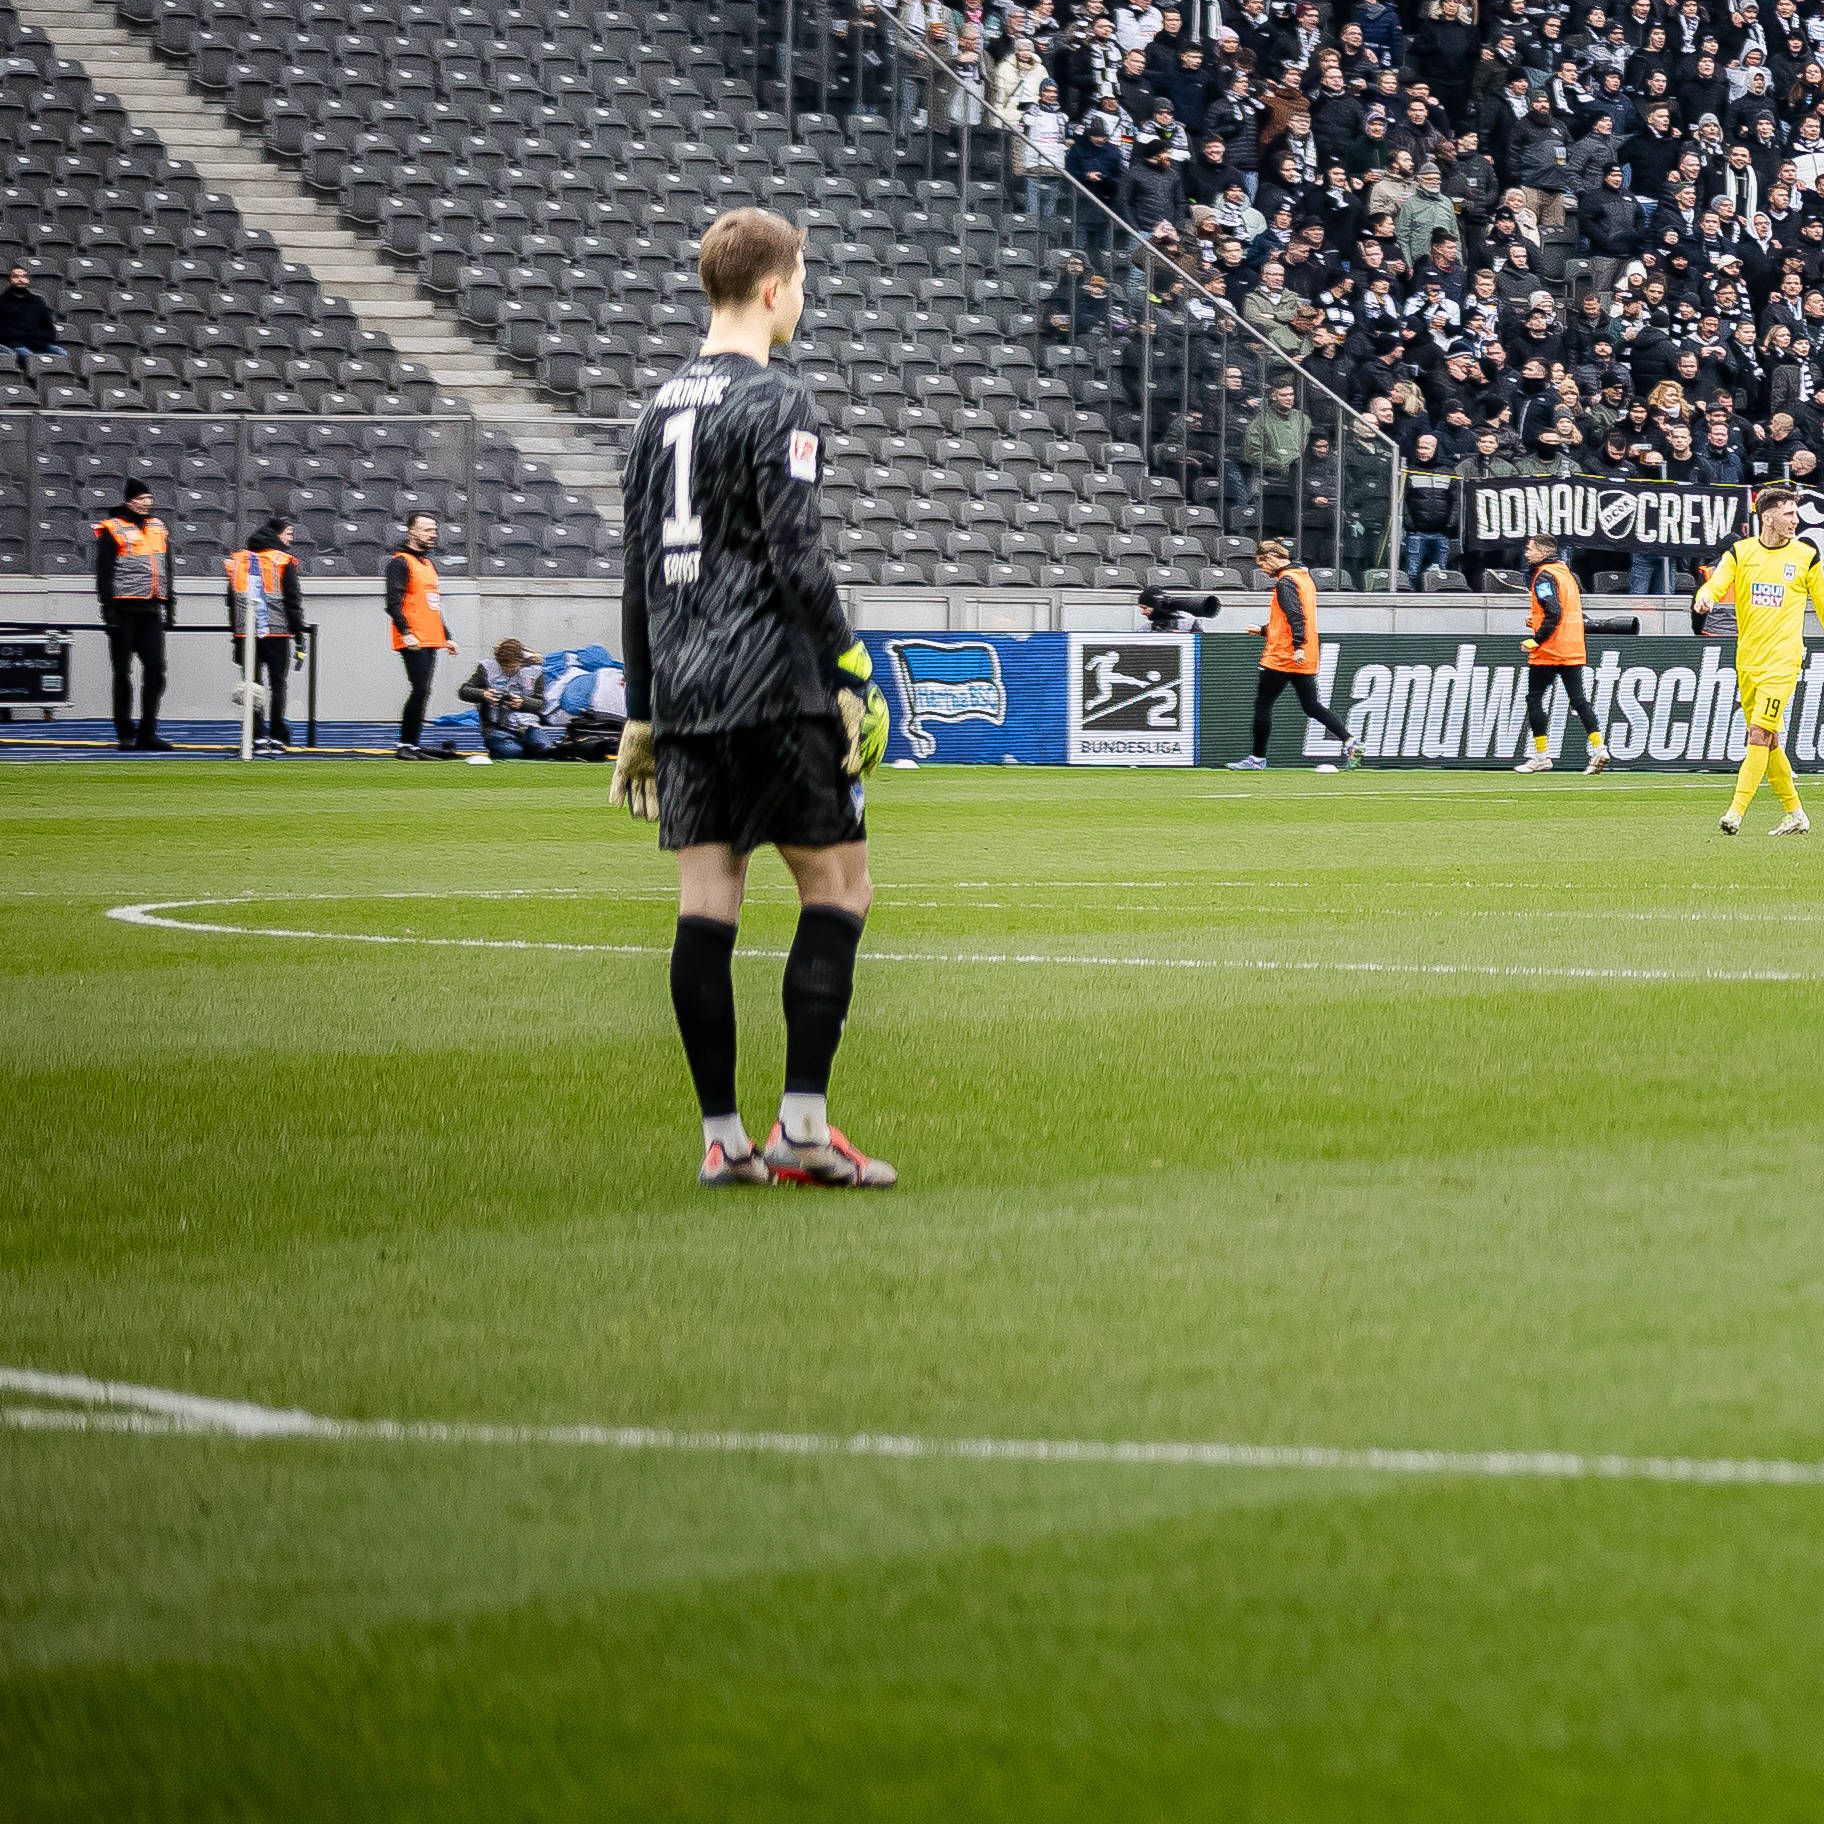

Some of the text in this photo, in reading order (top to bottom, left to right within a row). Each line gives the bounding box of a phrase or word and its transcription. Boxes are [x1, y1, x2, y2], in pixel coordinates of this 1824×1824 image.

[662, 407, 703, 548] 1
[1475, 482, 1599, 541] DONAU
[1635, 489, 1739, 547] CREW
[1753, 582, 1784, 597] LIQUI
[1752, 594, 1783, 607] MOLY
[1764, 696, 1781, 719] 19
[1081, 739, 1182, 755] BUNDESLIGA
